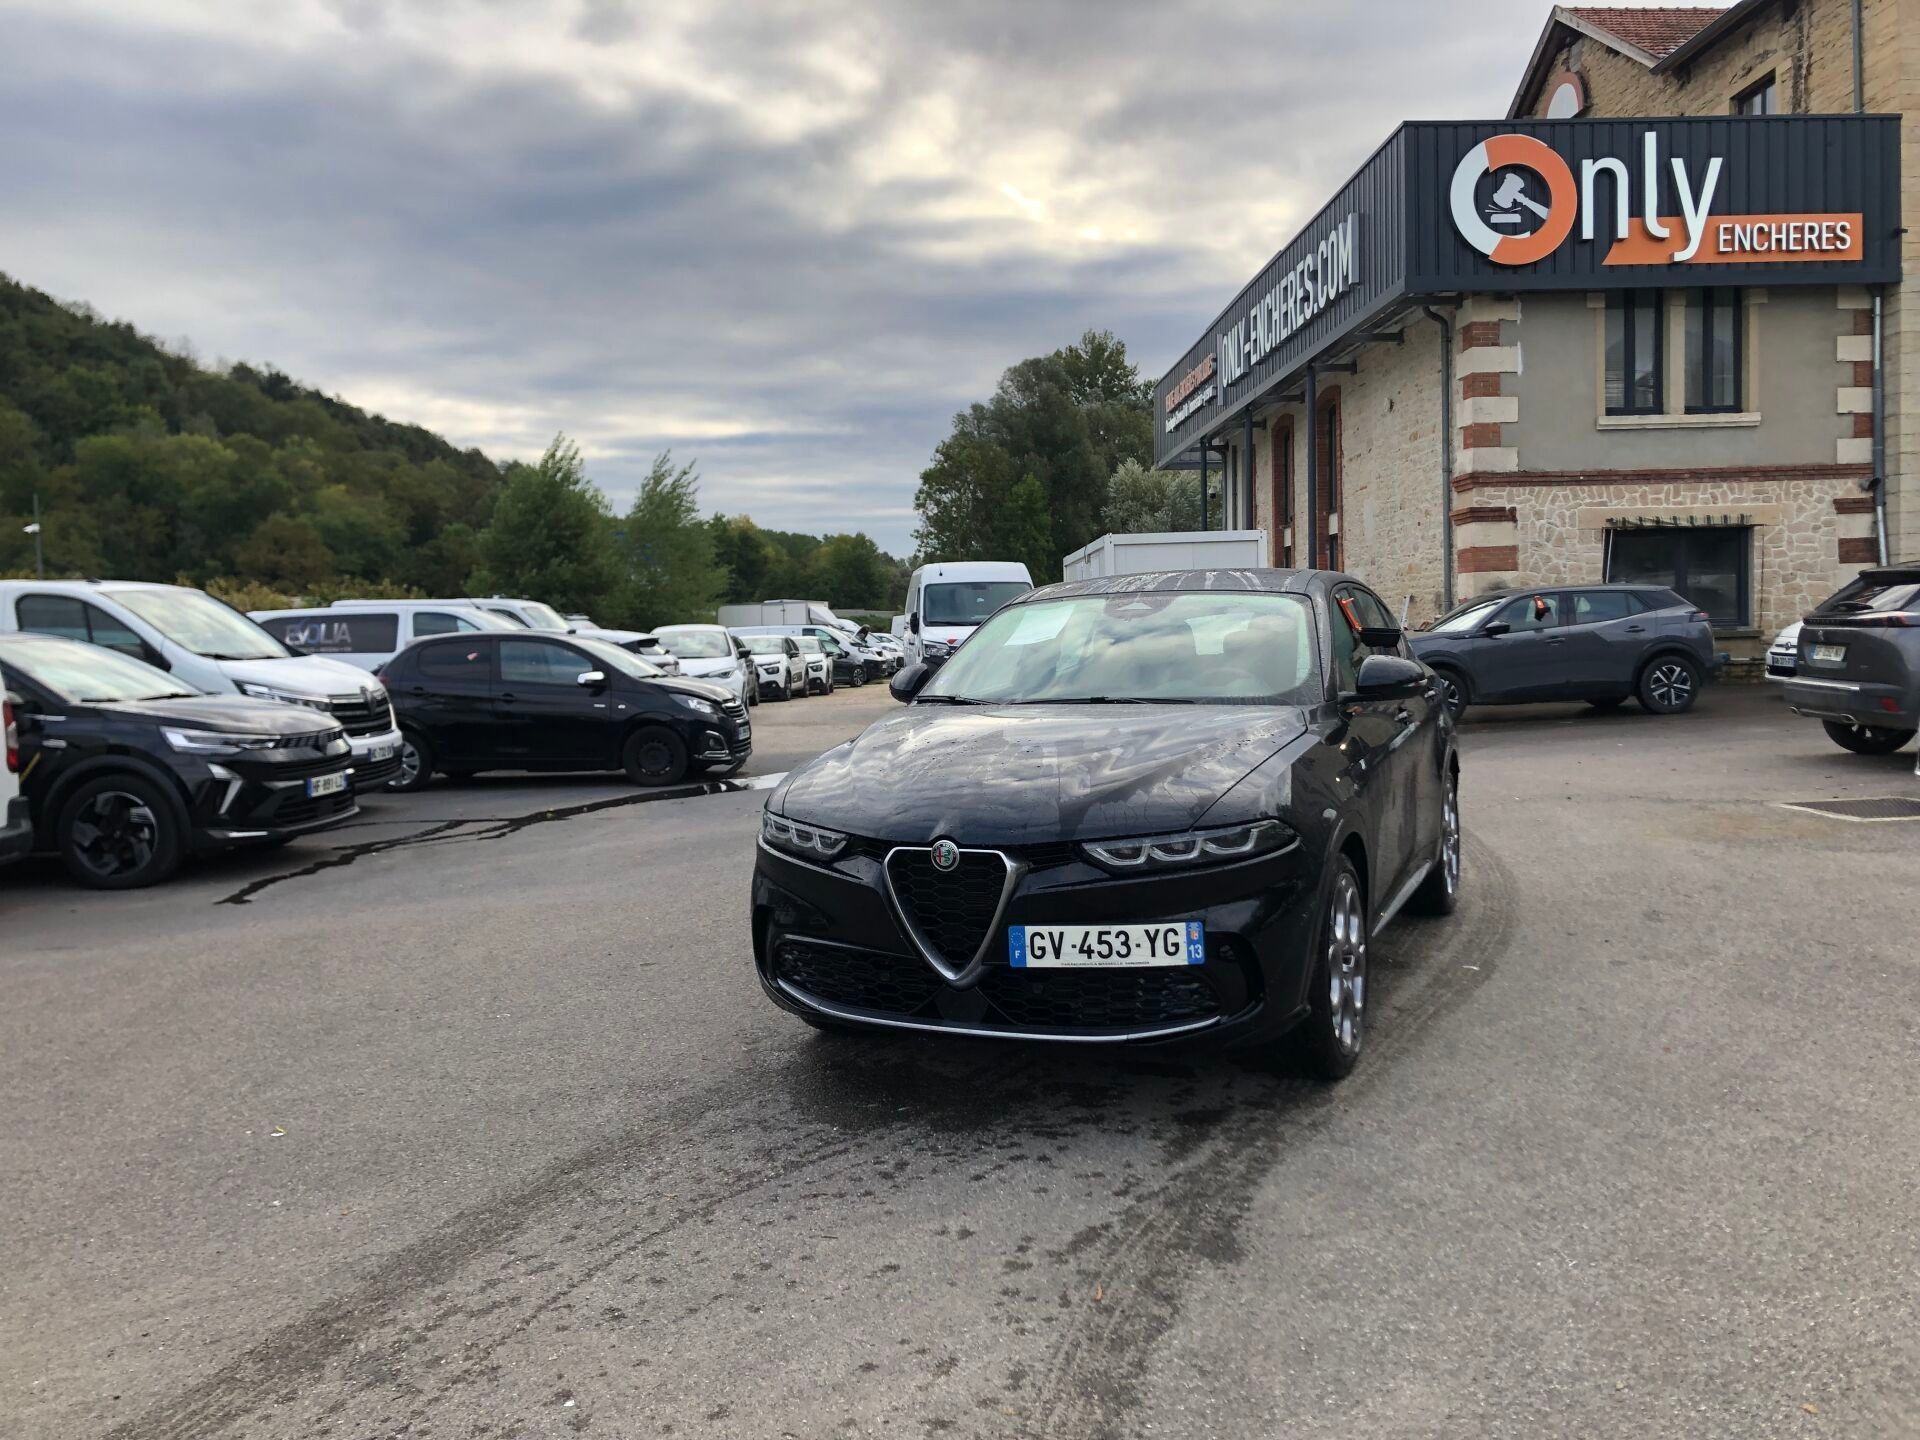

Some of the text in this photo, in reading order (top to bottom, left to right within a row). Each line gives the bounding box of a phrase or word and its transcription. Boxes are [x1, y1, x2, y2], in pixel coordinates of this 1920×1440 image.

[1450, 131, 1723, 265] Only
[1717, 220, 1852, 253] ENCHERES
[1221, 212, 1356, 388] ONLY-ENCHERES.COM
[1014, 950, 1021, 959] F
[1188, 943, 1202, 959] 13
